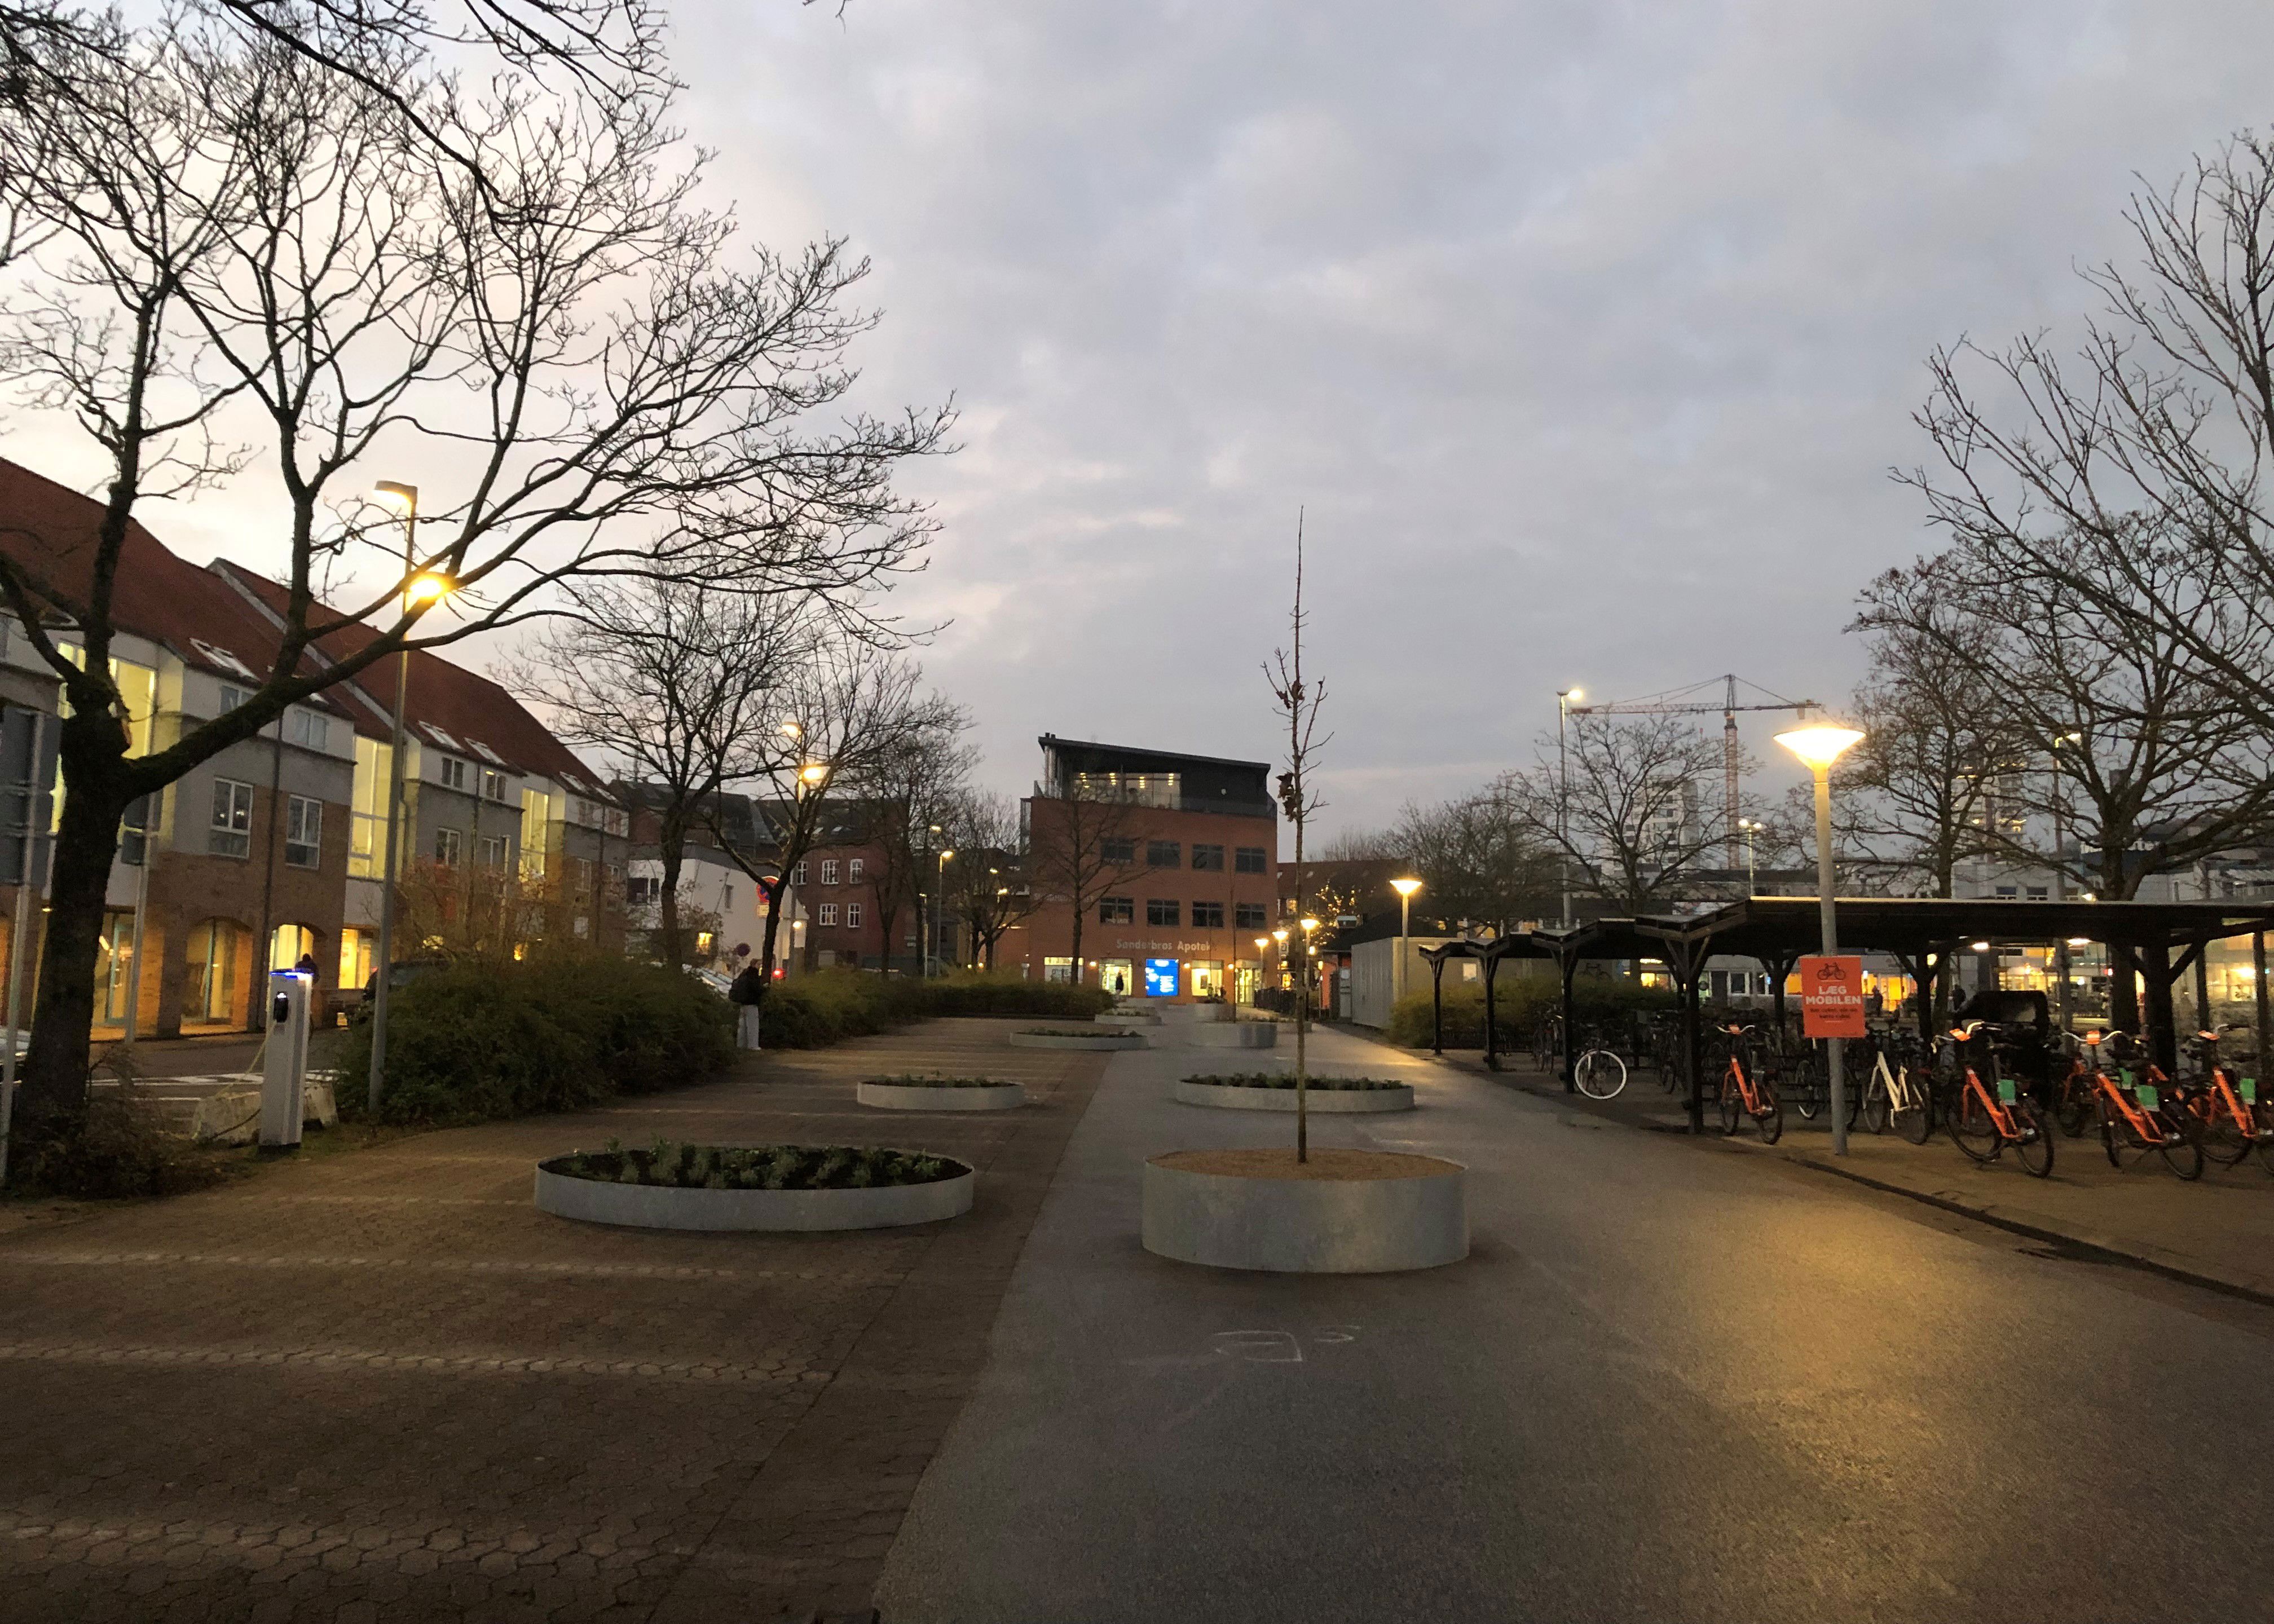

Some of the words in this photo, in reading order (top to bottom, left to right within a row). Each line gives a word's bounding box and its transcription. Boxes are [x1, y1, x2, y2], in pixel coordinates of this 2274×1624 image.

[1177, 941, 1211, 953] Apotek
[1818, 985, 1847, 995] LÆG
[1805, 995, 1861, 1005] MOBILEN
